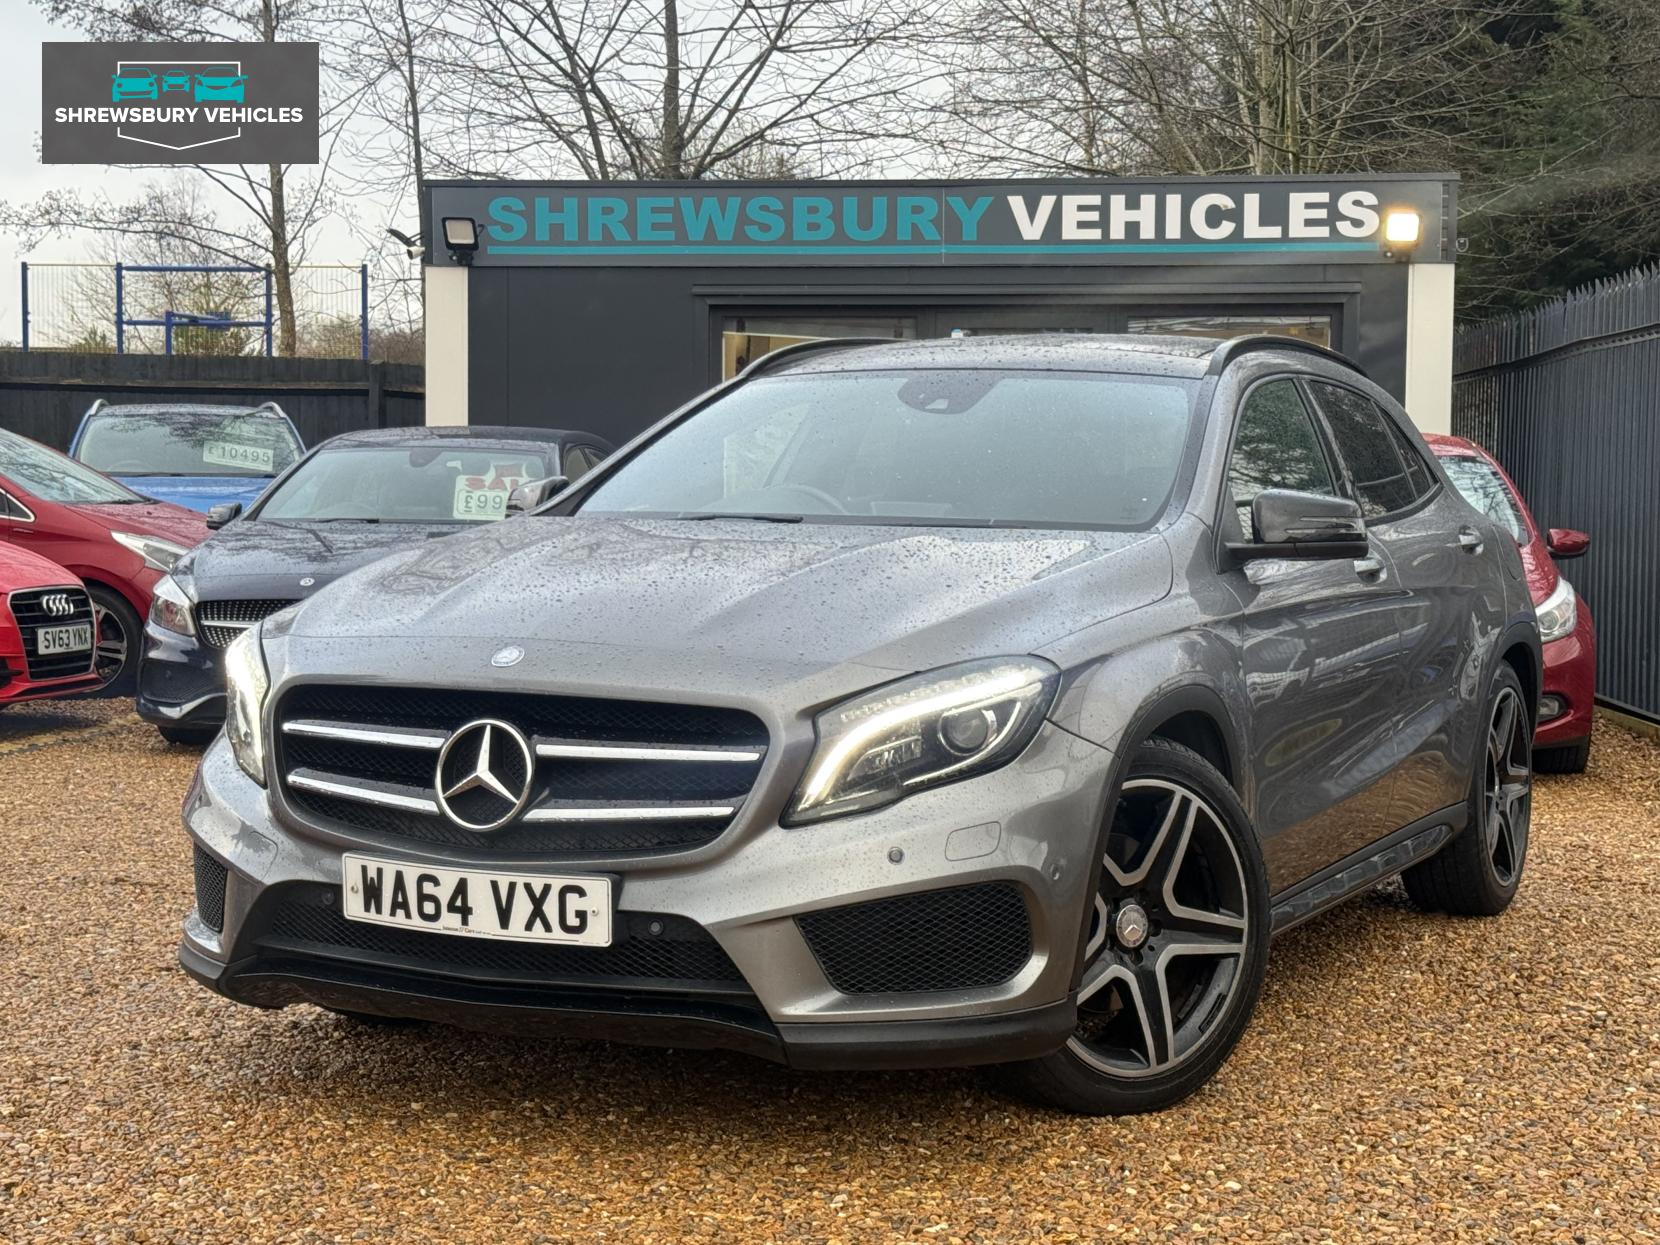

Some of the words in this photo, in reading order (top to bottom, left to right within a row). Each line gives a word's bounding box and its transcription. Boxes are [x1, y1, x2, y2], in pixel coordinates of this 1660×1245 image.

[487, 196, 993, 242] SHREWSBURY
[1007, 190, 1380, 241] VEHICLES
[43, 629, 71, 649] SV63
[72, 627, 88, 646] YNX
[361, 864, 474, 926] WA64
[490, 879, 588, 935] VXG
